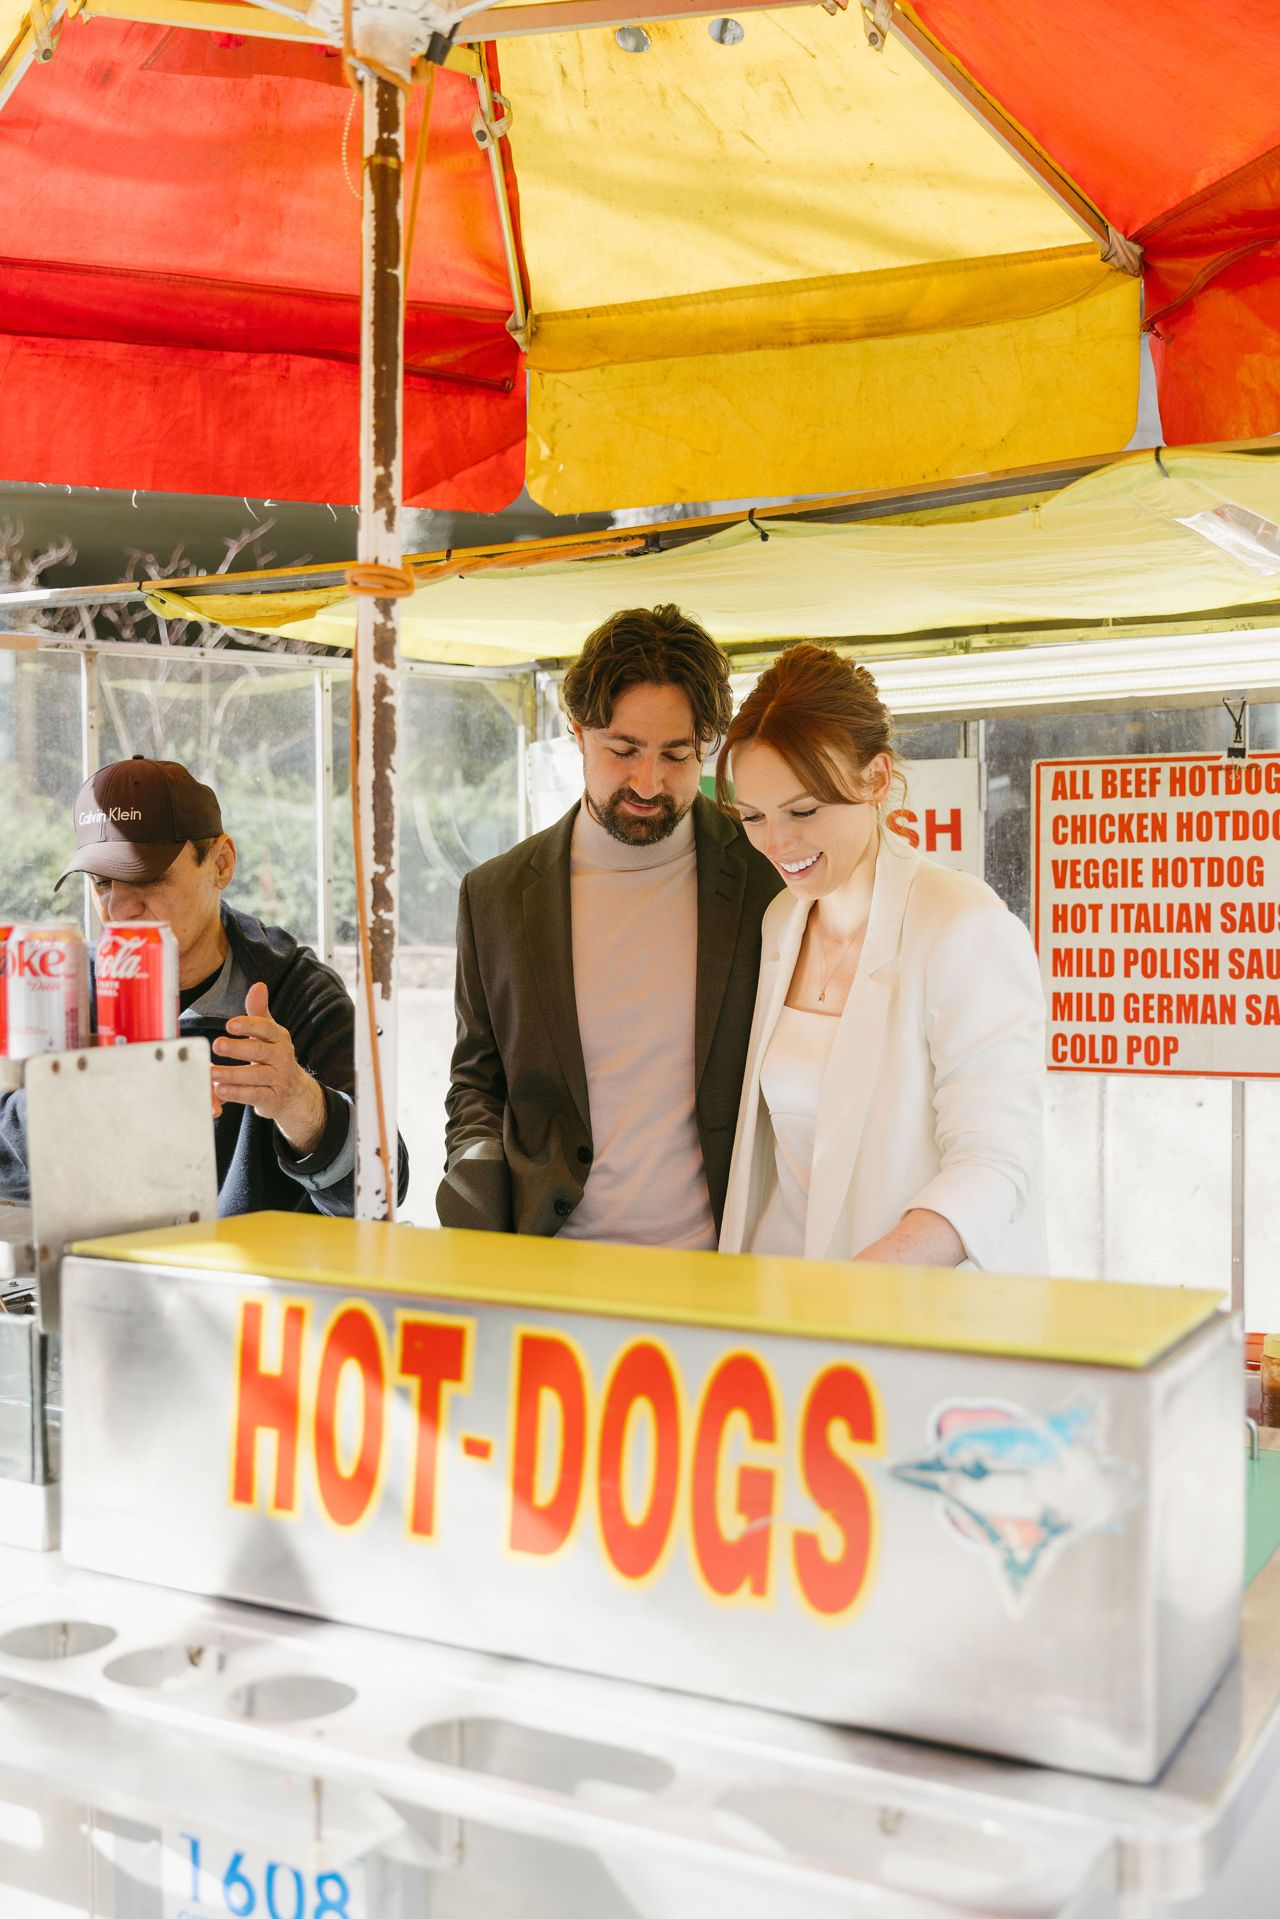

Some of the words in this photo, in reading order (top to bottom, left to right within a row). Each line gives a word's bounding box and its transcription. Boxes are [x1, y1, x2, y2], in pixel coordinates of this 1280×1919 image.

[1051, 769, 1094, 801] ALL
[1101, 767, 1162, 800] BEEF
[1169, 761, 1280, 798] HOTDOG
[78, 808, 107, 826] Calvin
[108, 806, 142, 822] Klein
[1051, 811, 1168, 846] CHICKEN
[1051, 857, 1145, 890] VEGGIE
[1151, 855, 1265, 889] HOTDOG
[1051, 902, 1104, 935] HOT
[1110, 902, 1212, 934] ITALIAN
[1219, 901, 1280, 934] SAU
[1051, 947, 1115, 979] MILD
[1123, 947, 1220, 980] POLISH
[1051, 991, 1115, 1023] MILD
[1123, 992, 1237, 1025] GERMAN
[1051, 1032, 1119, 1065] COLD
[1126, 1034, 1179, 1067] POP
[228, 1297, 886, 1625] HOT-DOGS
[178, 1831, 351, 1919] 1608
